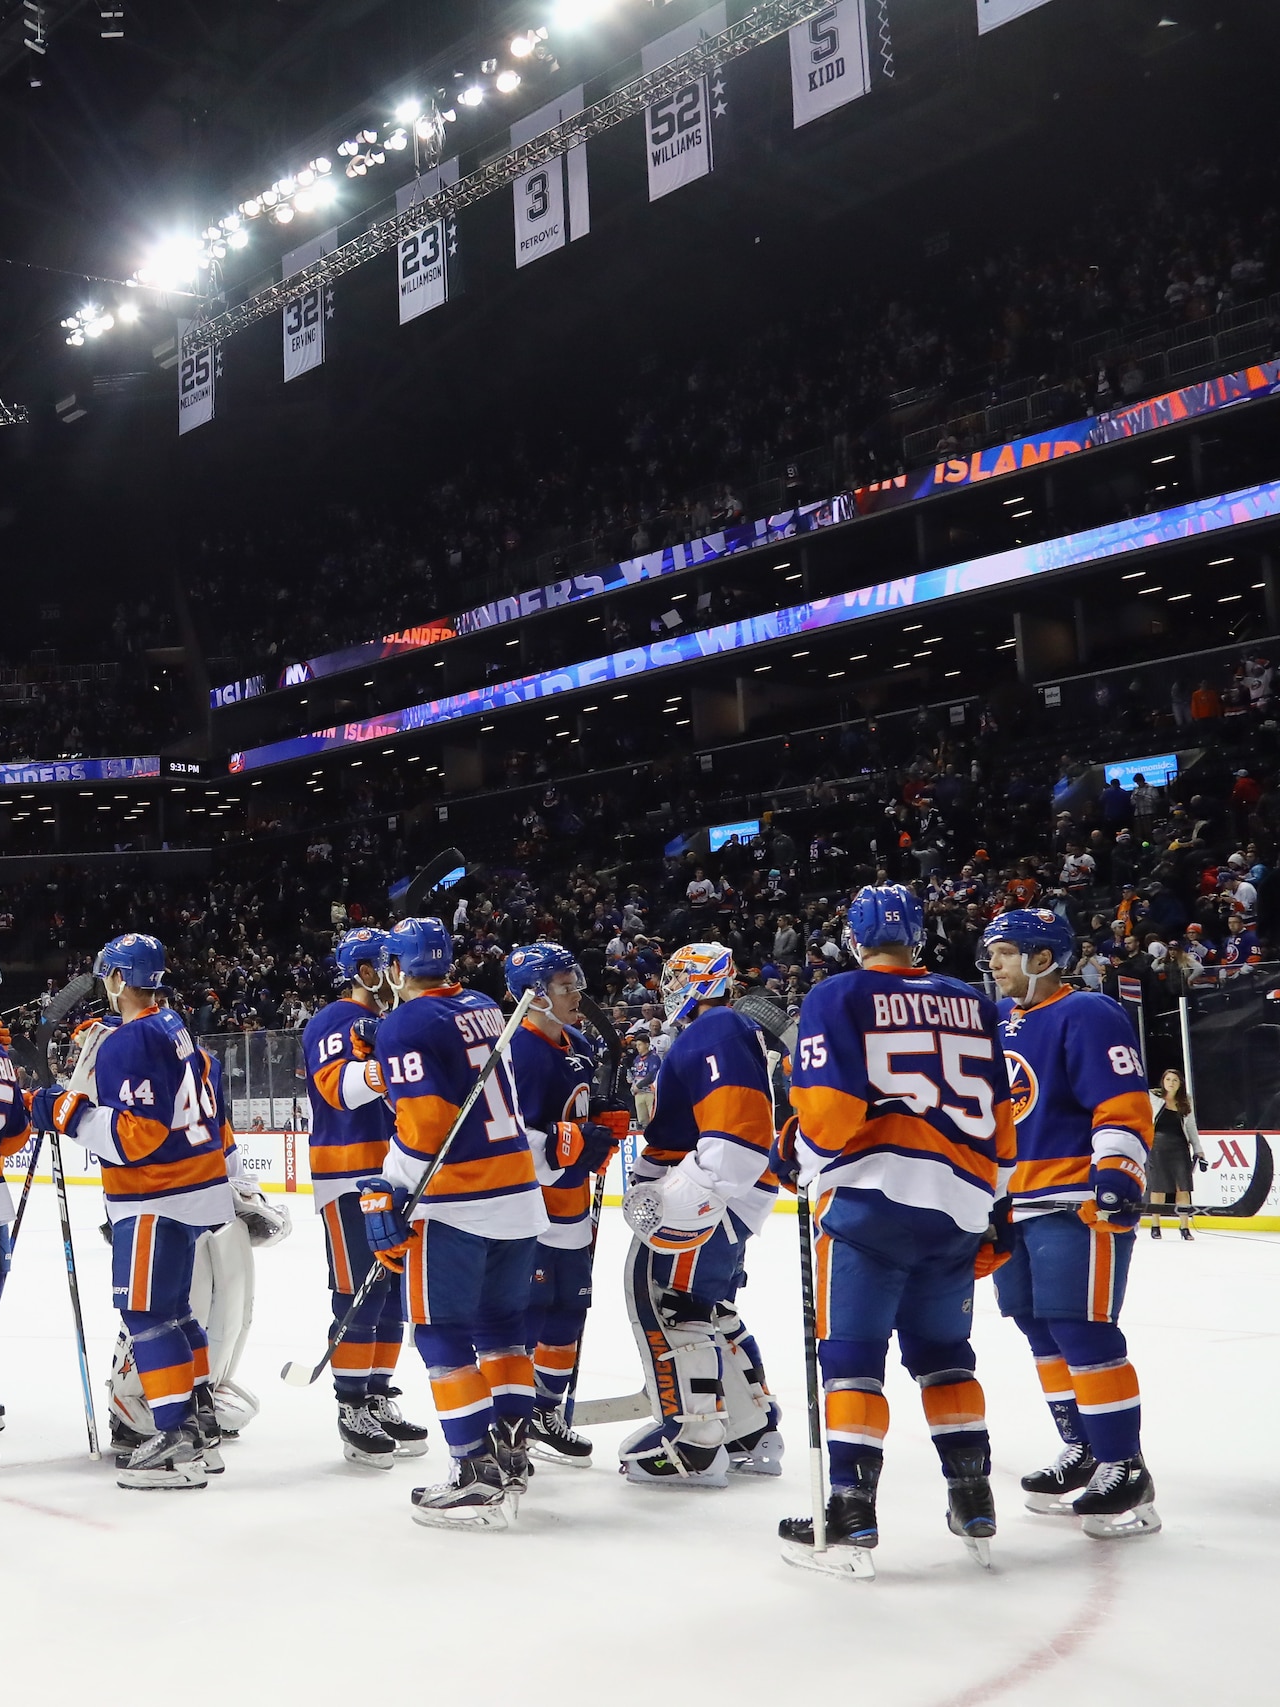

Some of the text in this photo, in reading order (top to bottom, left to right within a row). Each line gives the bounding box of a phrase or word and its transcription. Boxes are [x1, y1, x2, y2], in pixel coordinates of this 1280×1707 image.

[810, 10, 839, 64] 5
[808, 58, 845, 92] KIDD
[651, 87, 701, 145] 52
[651, 129, 702, 167] WILLIAMS
[527, 170, 550, 222] 3
[402, 228, 439, 279] 23
[520, 225, 559, 252] PETROVIC
[401, 264, 442, 296] WILLIAMSON
[287, 295, 319, 336] 32
[292, 329, 317, 352] ERVING
[181, 351, 209, 395] 25
[180, 385, 211, 411] MELCHIONNI
[620, 531, 726, 584] WIN
[843, 575, 916, 607] WIN
[696, 615, 779, 656] WIN
[170, 762, 200, 774] 9:31 PM
[885, 911, 900, 922] 55
[431, 948, 443, 959] 18
[873, 993, 984, 1031] BOYCHUK
[318, 1032, 343, 1064] 16
[800, 1034, 827, 1071] 55
[388, 1051, 424, 1084] 18
[706, 1055, 720, 1083] 1
[864, 1030, 997, 1140] 55
[119, 1079, 154, 1107] 44
[286, 1134, 294, 1180] Reebok
